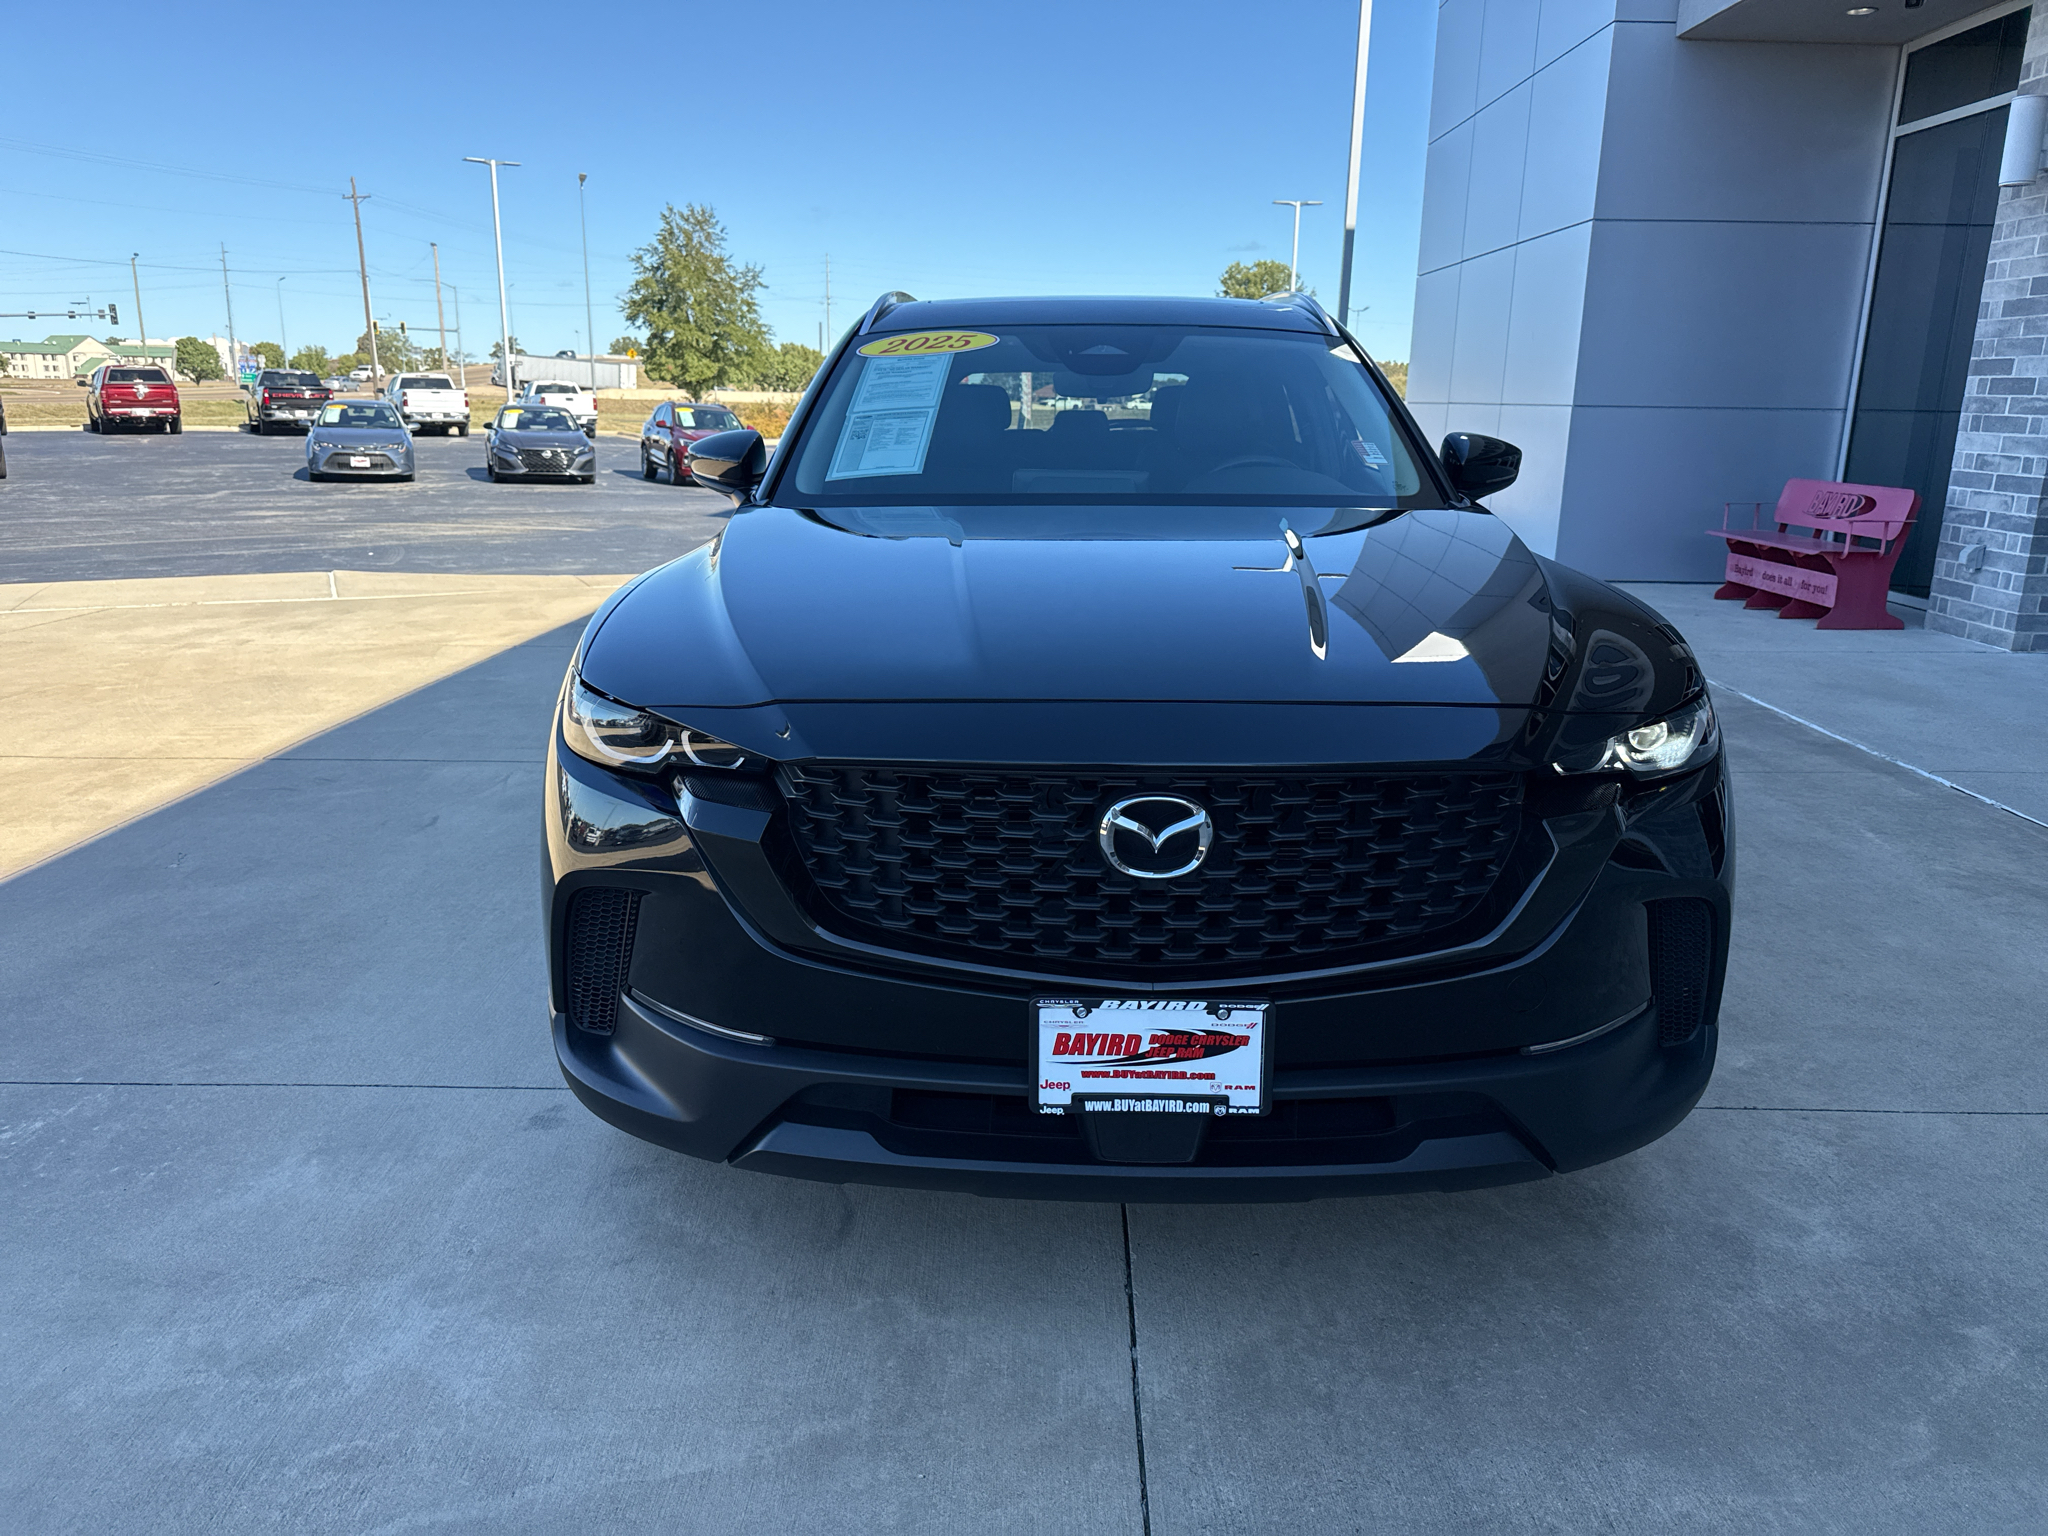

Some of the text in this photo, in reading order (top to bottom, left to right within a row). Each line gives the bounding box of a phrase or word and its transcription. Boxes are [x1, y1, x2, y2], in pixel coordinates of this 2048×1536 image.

[878, 335, 978, 354] 2025
[1806, 490, 1859, 517] BAYIRD
[1734, 564, 1828, 595] Bayird does it all for you!
[1100, 1000, 1208, 1010] BAYIRD
[1052, 1033, 1142, 1056] BAYIRD
[1148, 1034, 1250, 1046] DODGE CHRYSLER
[1145, 1047, 1205, 1058] JEEP RAM
[1081, 1070, 1216, 1080] www.BUYatBAYIRD.com
[1040, 1079, 1070, 1091] Jeep
[1040, 1106, 1064, 1115] Jeep
[1084, 1099, 1210, 1114] www.BUYatBAYIRD.com
